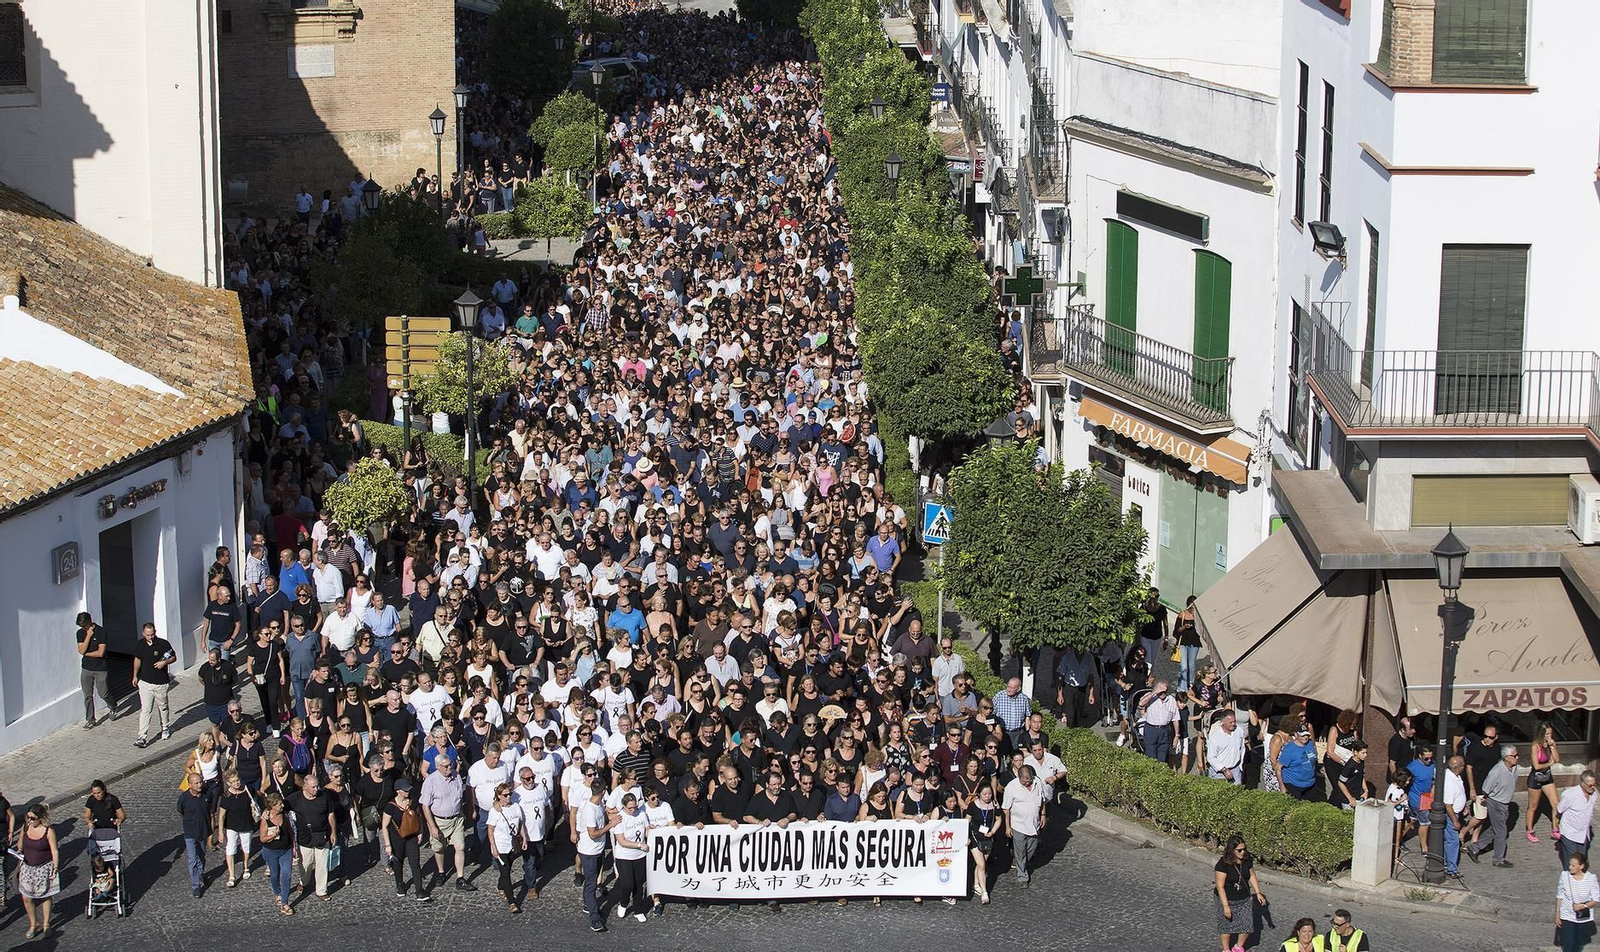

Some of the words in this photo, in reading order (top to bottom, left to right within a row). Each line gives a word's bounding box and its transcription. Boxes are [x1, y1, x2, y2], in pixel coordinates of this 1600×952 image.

[1108, 412, 1209, 468] FARMACIA
[1128, 475, 1150, 497] botica
[64, 554, 75, 572] 24
[1473, 635, 1599, 677] Avalos
[1462, 687, 1588, 709] ZAPATOS
[653, 835, 689, 874] POR
[695, 834, 732, 874] UNA
[740, 830, 805, 872] CIUDAD
[811, 825, 849, 870] MÁS
[855, 828, 927, 869] SEGURA
[680, 871, 899, 892] 为了城市更加安全
